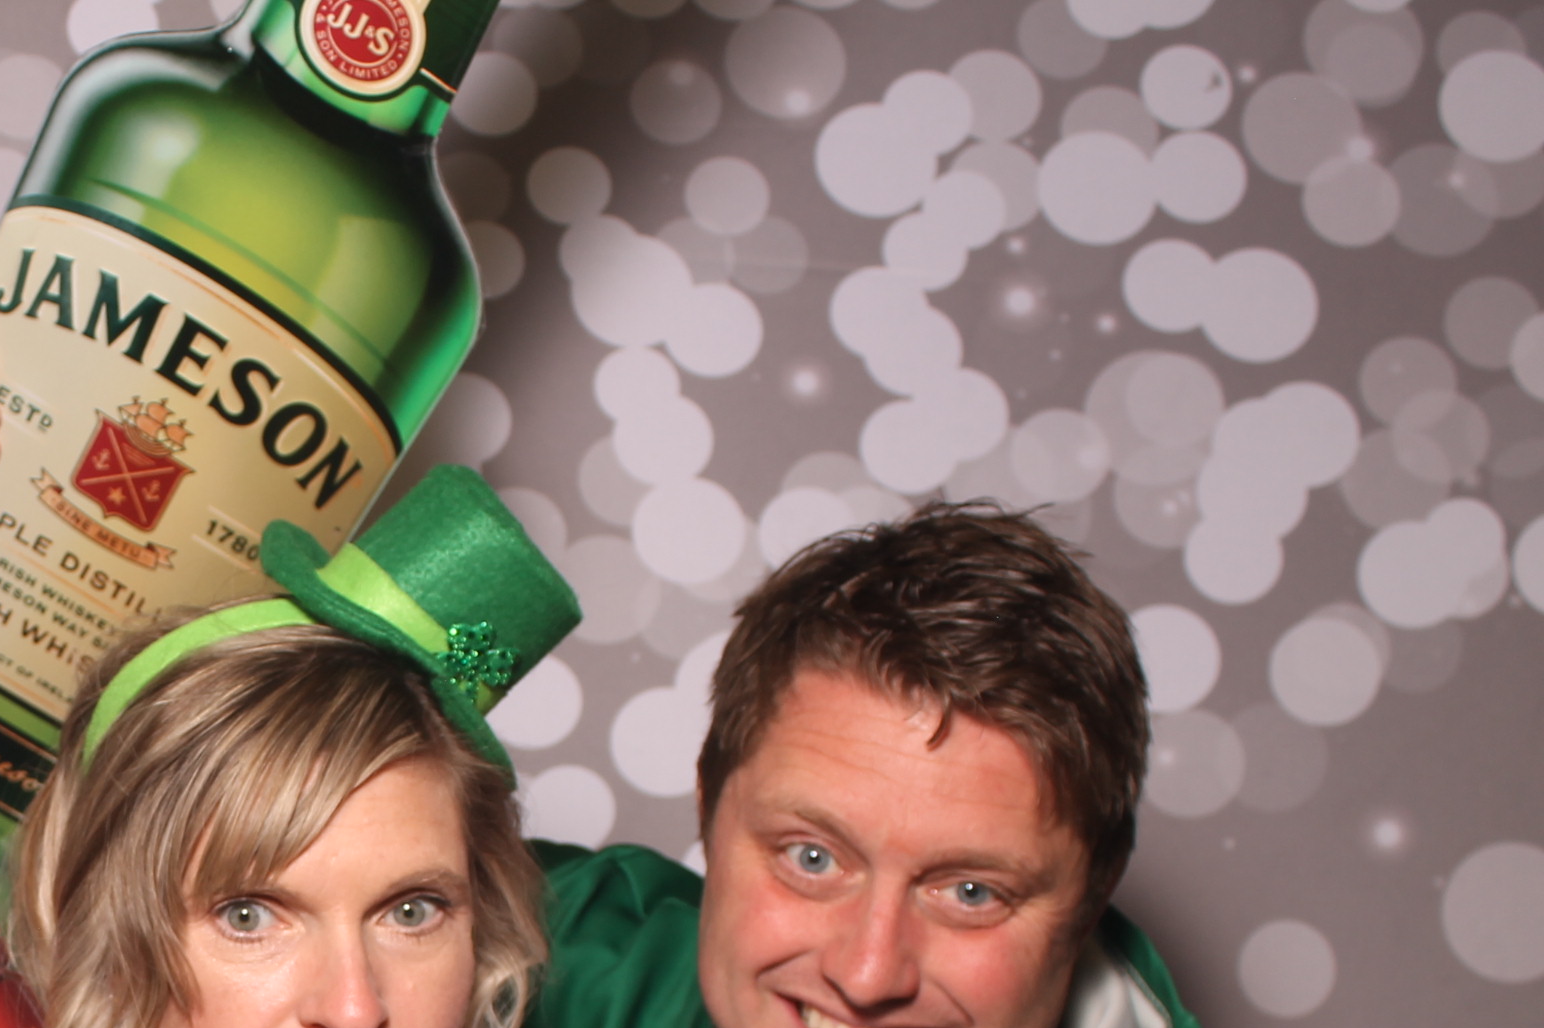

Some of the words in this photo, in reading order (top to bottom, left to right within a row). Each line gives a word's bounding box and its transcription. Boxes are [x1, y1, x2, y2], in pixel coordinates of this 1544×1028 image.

[326, 3, 395, 56] JJ&S
[339, 59, 398, 79] LIMITED
[206, 519, 259, 561] 1780
[60, 551, 162, 625] DISTIL
[21, 618, 95, 675] WHIS
[52, 611, 88, 638] WAY
